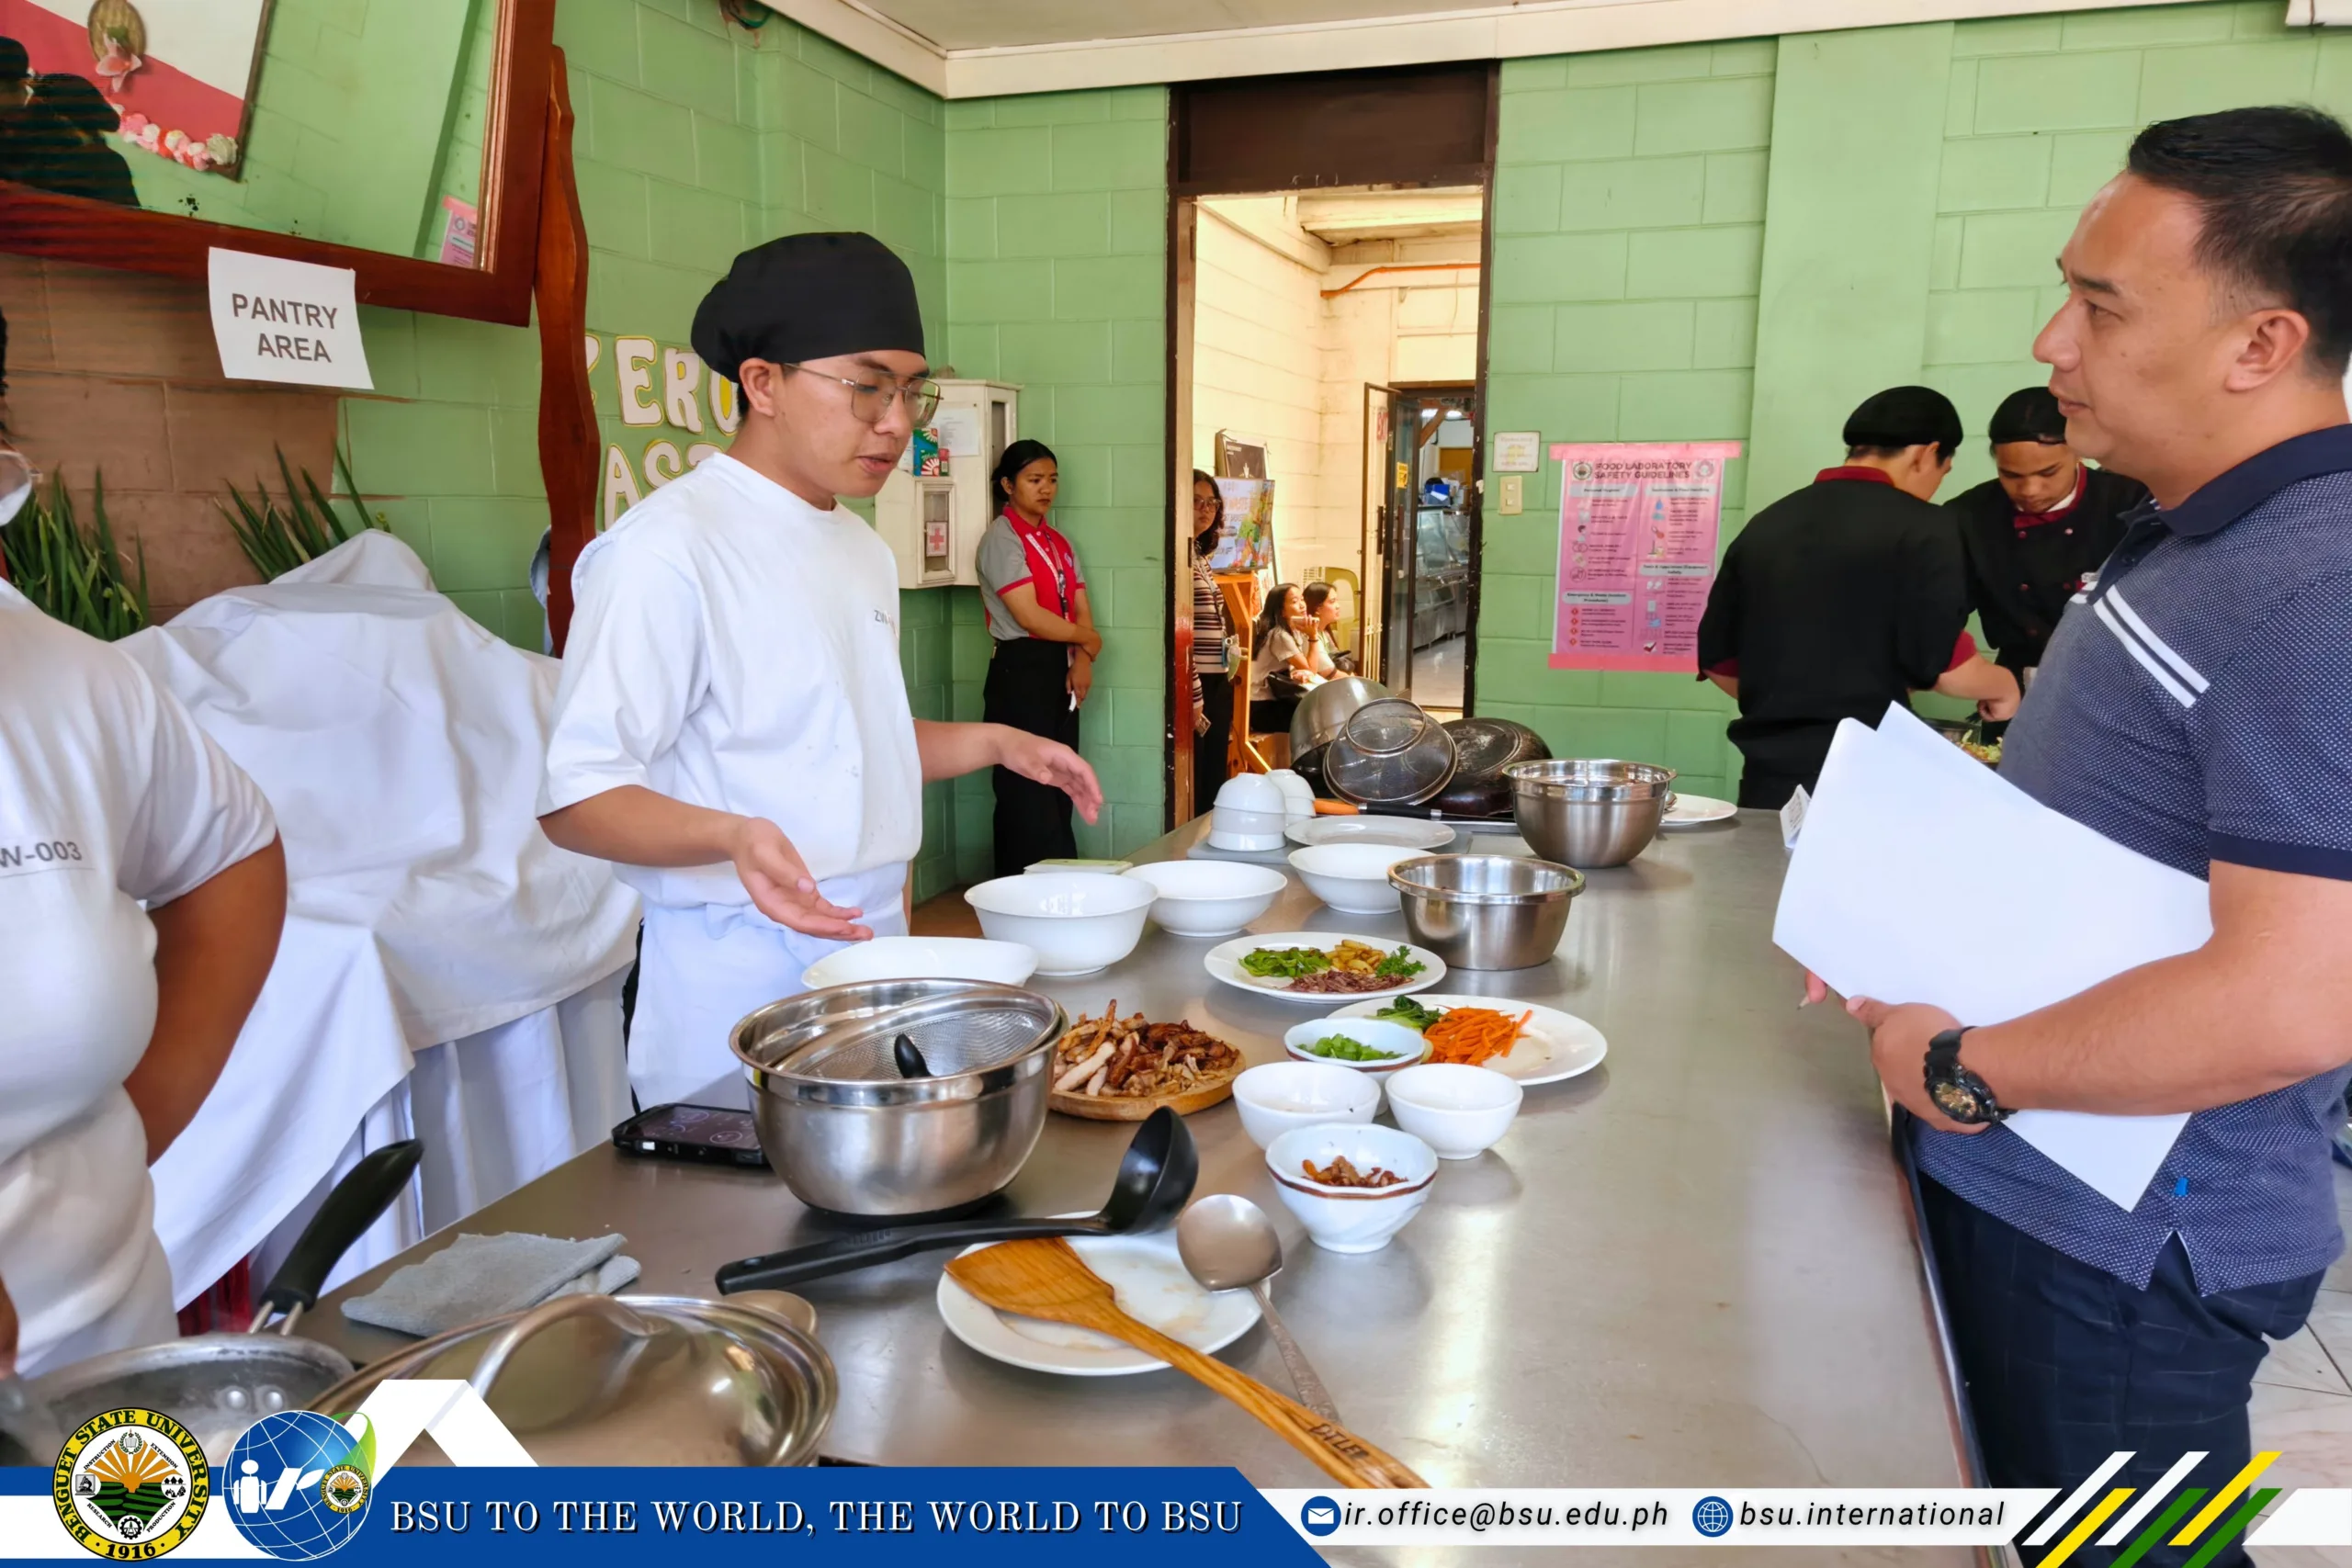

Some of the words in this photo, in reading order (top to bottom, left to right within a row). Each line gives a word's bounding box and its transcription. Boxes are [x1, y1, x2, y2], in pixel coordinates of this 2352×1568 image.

[232, 293, 337, 329] PANTRY
[257, 333, 332, 363] AREA
[585, 332, 739, 437] ERO
[1594, 470, 1632, 479] SAFETY
[1634, 470, 1690, 479] GUIDELINES
[1595, 462, 1623, 470] FOOD
[1625, 461, 1692, 470] LABORATORY
